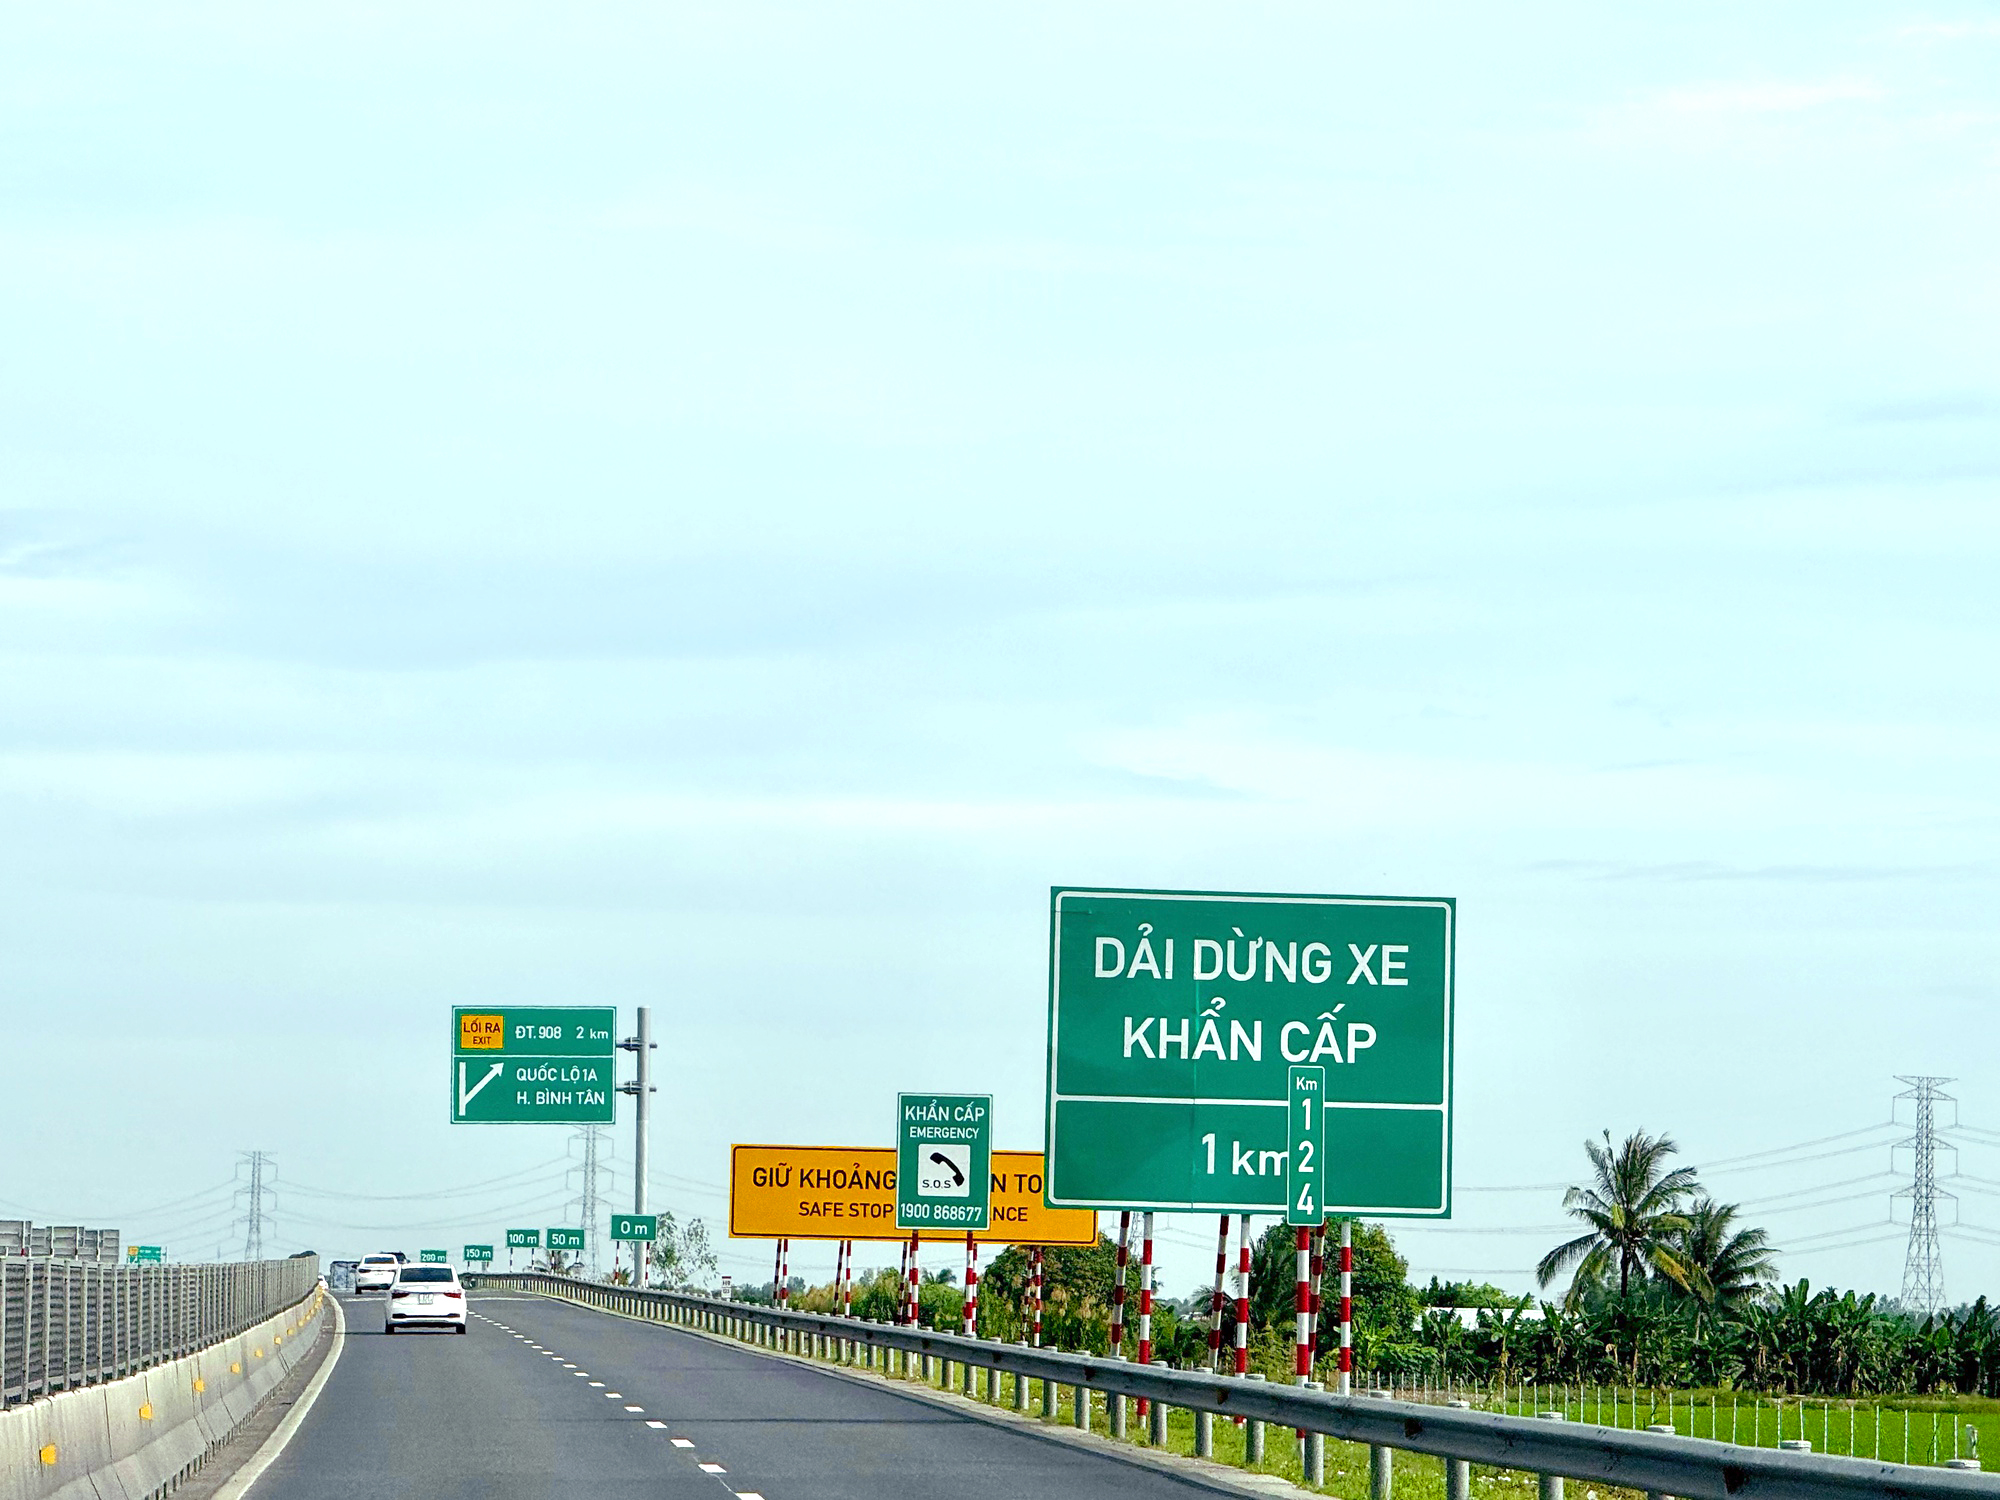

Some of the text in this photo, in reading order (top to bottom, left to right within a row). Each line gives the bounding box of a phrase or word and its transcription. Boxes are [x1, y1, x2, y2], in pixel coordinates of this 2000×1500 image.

[1095, 923, 1408, 985] DẢI DỪNG XE
[464, 1018, 500, 1033] LỐI RA
[515, 1026, 608, 1039] ĐT.908 2 km
[1124, 997, 1376, 1063] KHẨN CẤP
[473, 1036, 491, 1044] EXIT
[517, 1063, 557, 1081] QUỐC
[1297, 1077, 1317, 1090] Km
[517, 1088, 604, 1104] H. BÌNH TÂN
[906, 1099, 984, 1121] KHẨN CẤP
[910, 1127, 979, 1138] EMERGENCY
[1202, 1134, 1287, 1176] 1 km
[753, 1163, 1042, 1193] GIỮ KHOẢNG N TO
[799, 1202, 1028, 1221] SAFE STOP NCE
[901, 1203, 982, 1221] 1900 868677
[621, 1221, 647, 1234] 0 m
[509, 1234, 524, 1243] 100
[552, 1234, 579, 1245] 50 m
[421, 1254, 436, 1262] 200
[467, 1249, 480, 1257] 150
